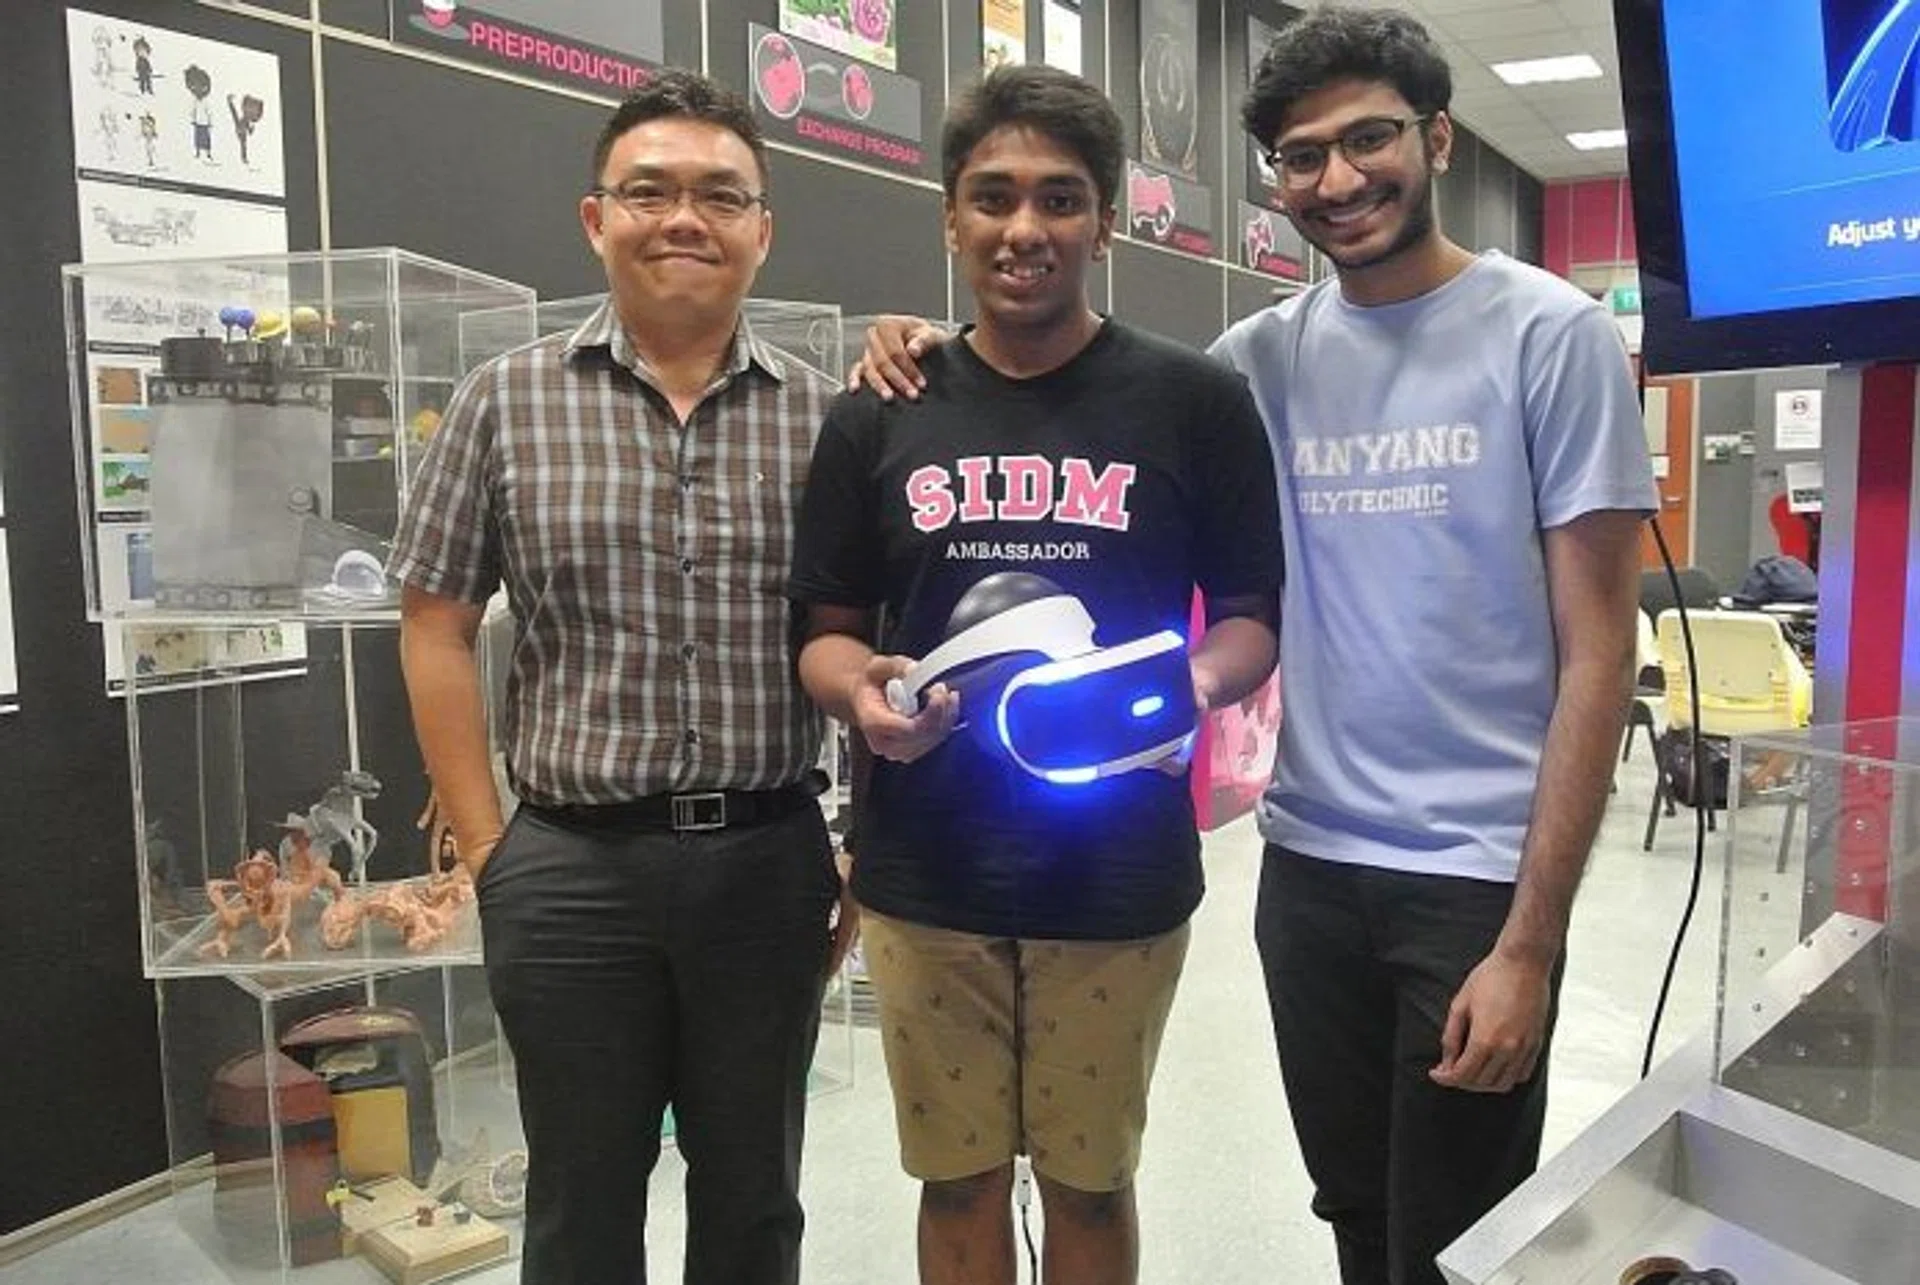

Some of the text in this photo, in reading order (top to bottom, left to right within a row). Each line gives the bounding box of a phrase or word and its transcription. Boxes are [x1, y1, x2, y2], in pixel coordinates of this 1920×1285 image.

[1827, 216, 1920, 247] Adjust y
[906, 455, 1136, 532] SIDM
[946, 541, 1090, 560] AMBASSADOR
